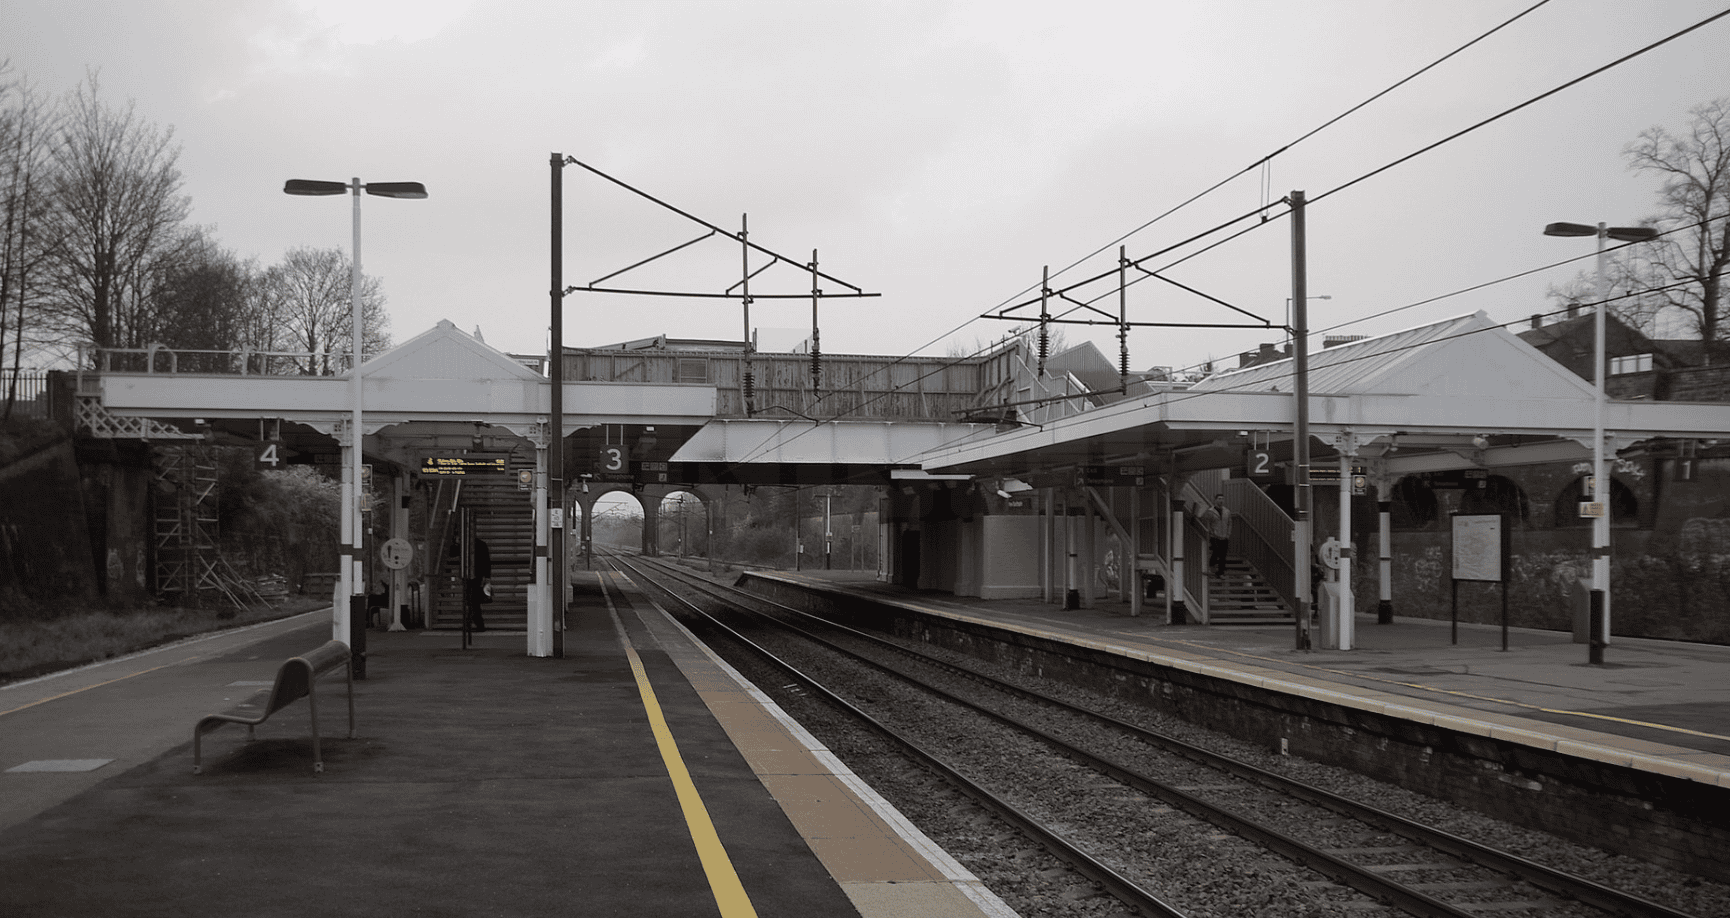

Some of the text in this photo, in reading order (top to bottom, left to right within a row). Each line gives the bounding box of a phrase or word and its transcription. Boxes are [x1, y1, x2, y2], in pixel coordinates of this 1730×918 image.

[259, 444, 280, 467] 4
[605, 448, 622, 471] 3
[1254, 453, 1270, 474] 2
[1682, 460, 1692, 480] 1
